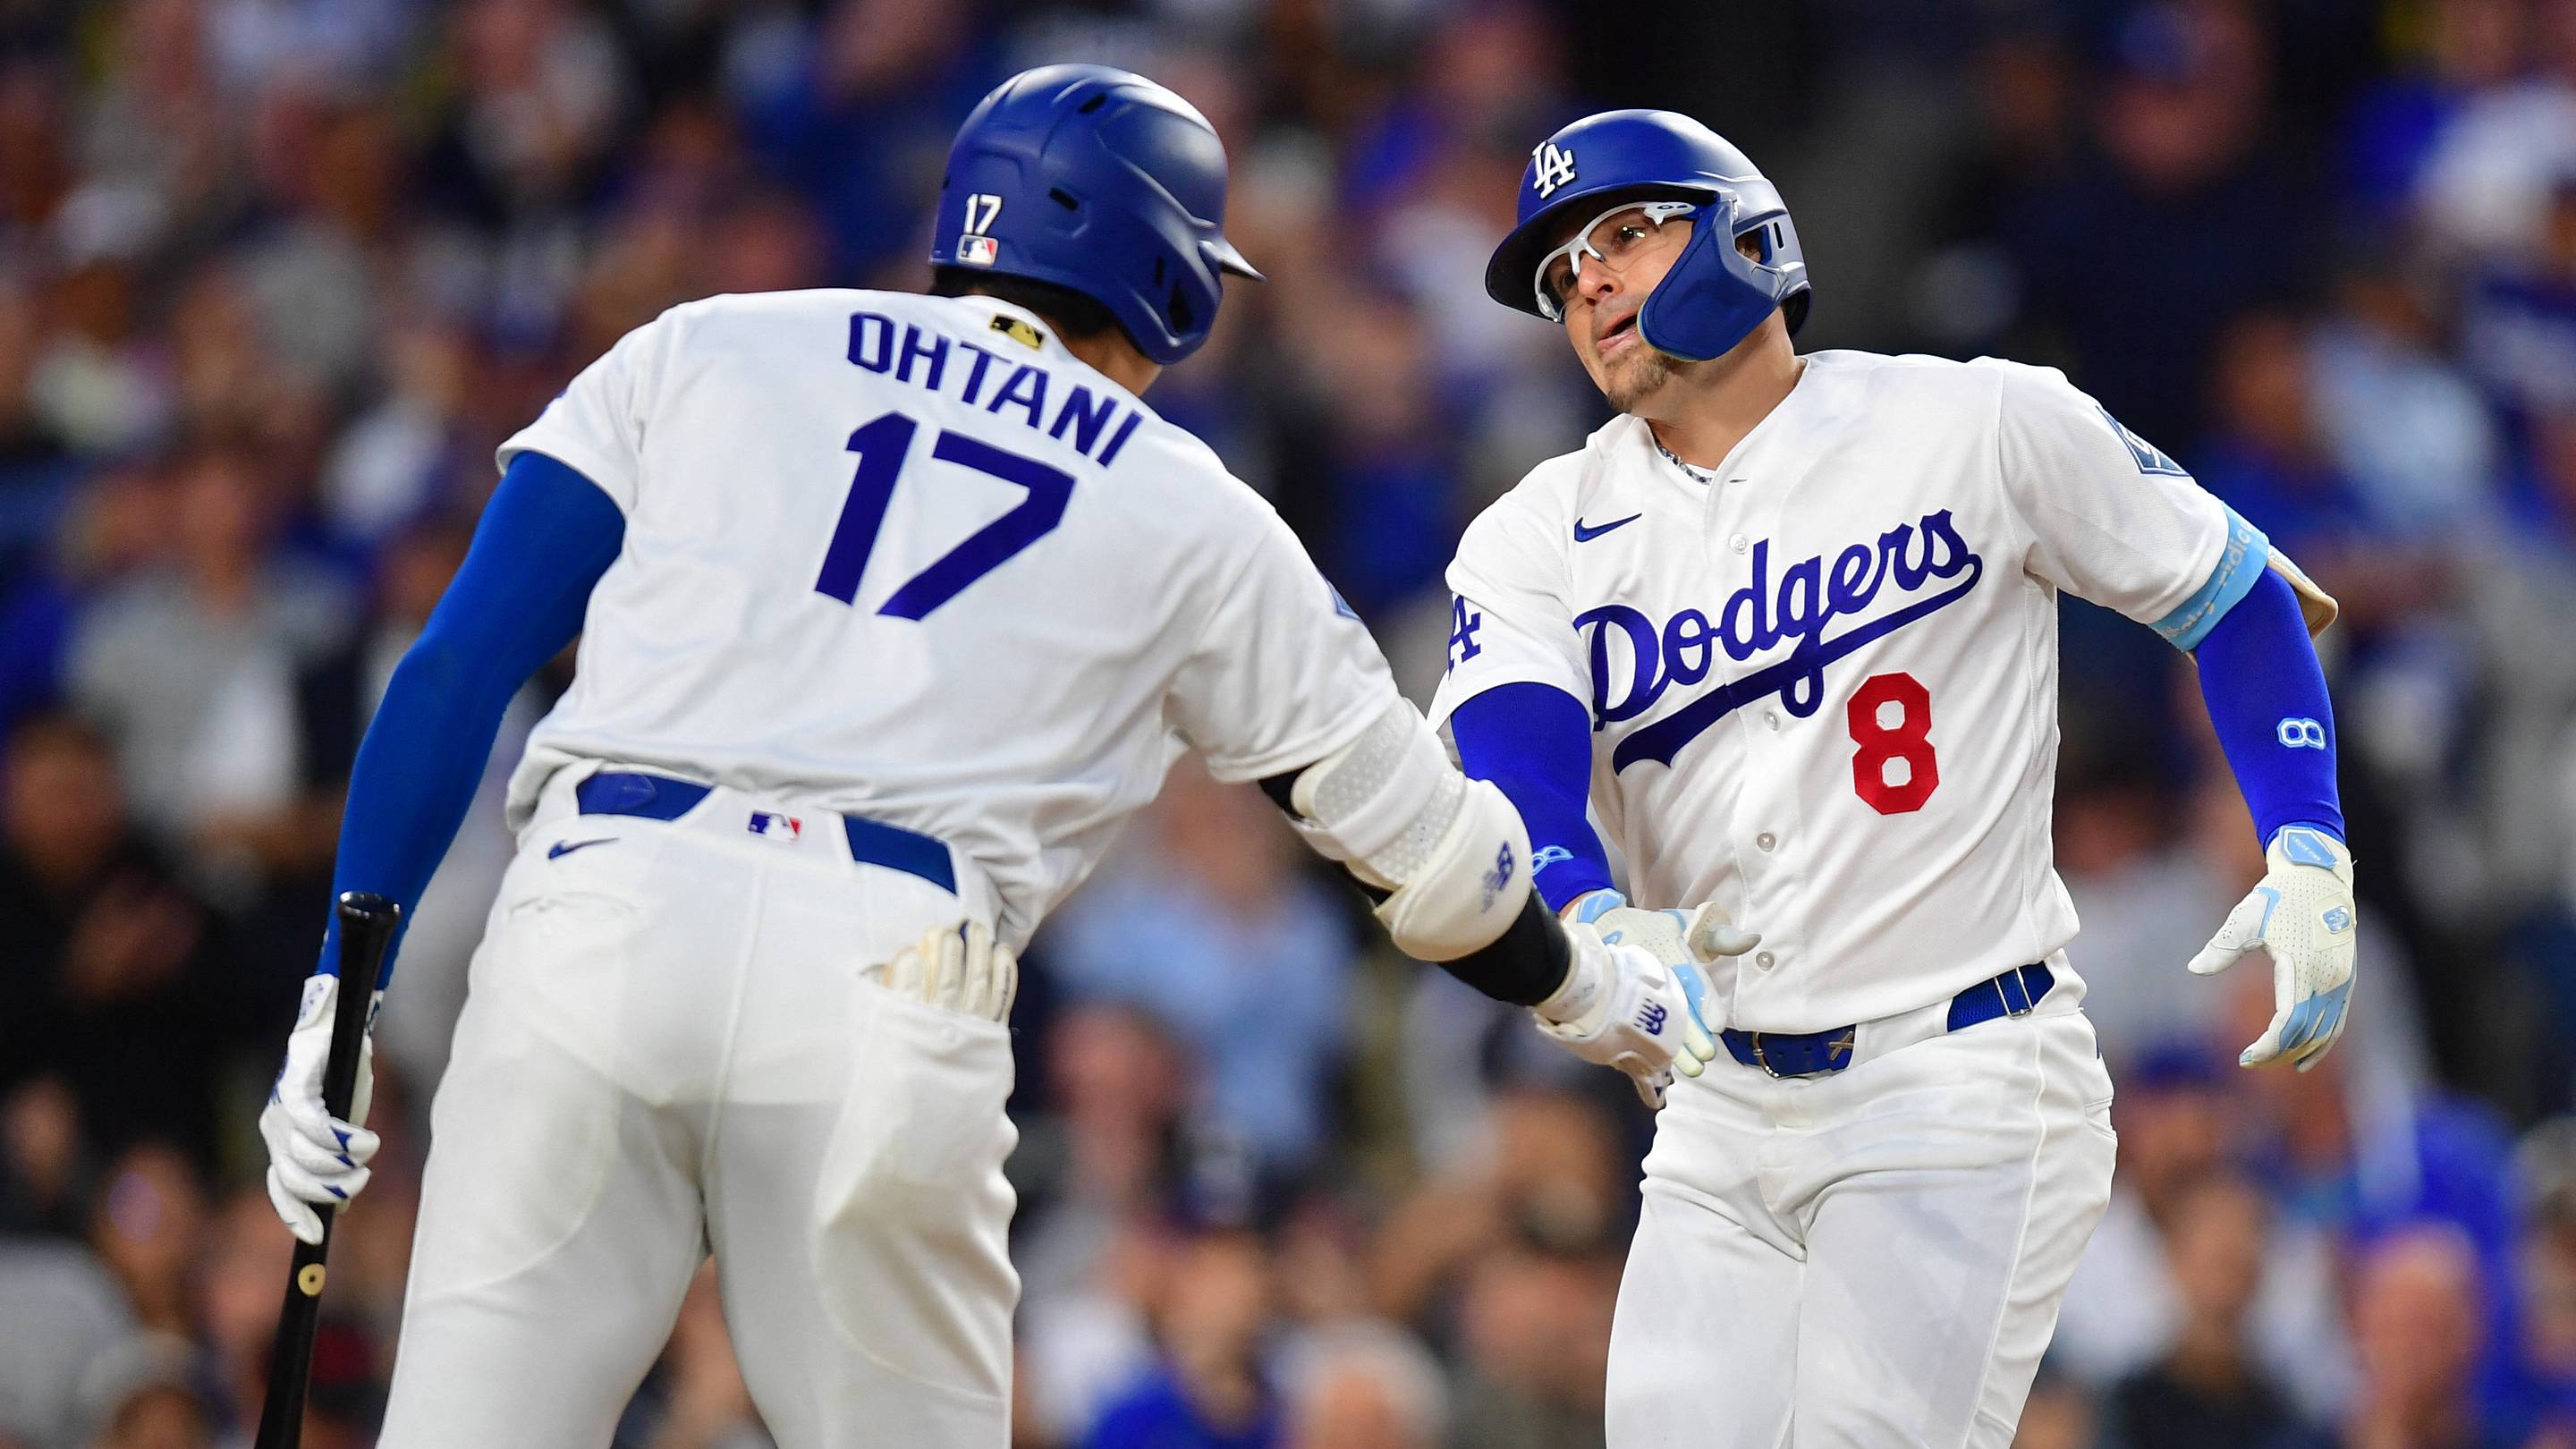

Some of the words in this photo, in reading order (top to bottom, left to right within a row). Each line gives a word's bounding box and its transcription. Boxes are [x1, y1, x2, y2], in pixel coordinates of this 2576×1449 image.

[963, 193, 1003, 235] 17
[1532, 140, 1576, 199] LA
[848, 312, 1142, 468] OHTANI
[815, 411, 1076, 621] 17
[1573, 508, 1982, 732] Dodgers
[1847, 671, 1940, 816] 8
[2276, 716, 2326, 750] 8
